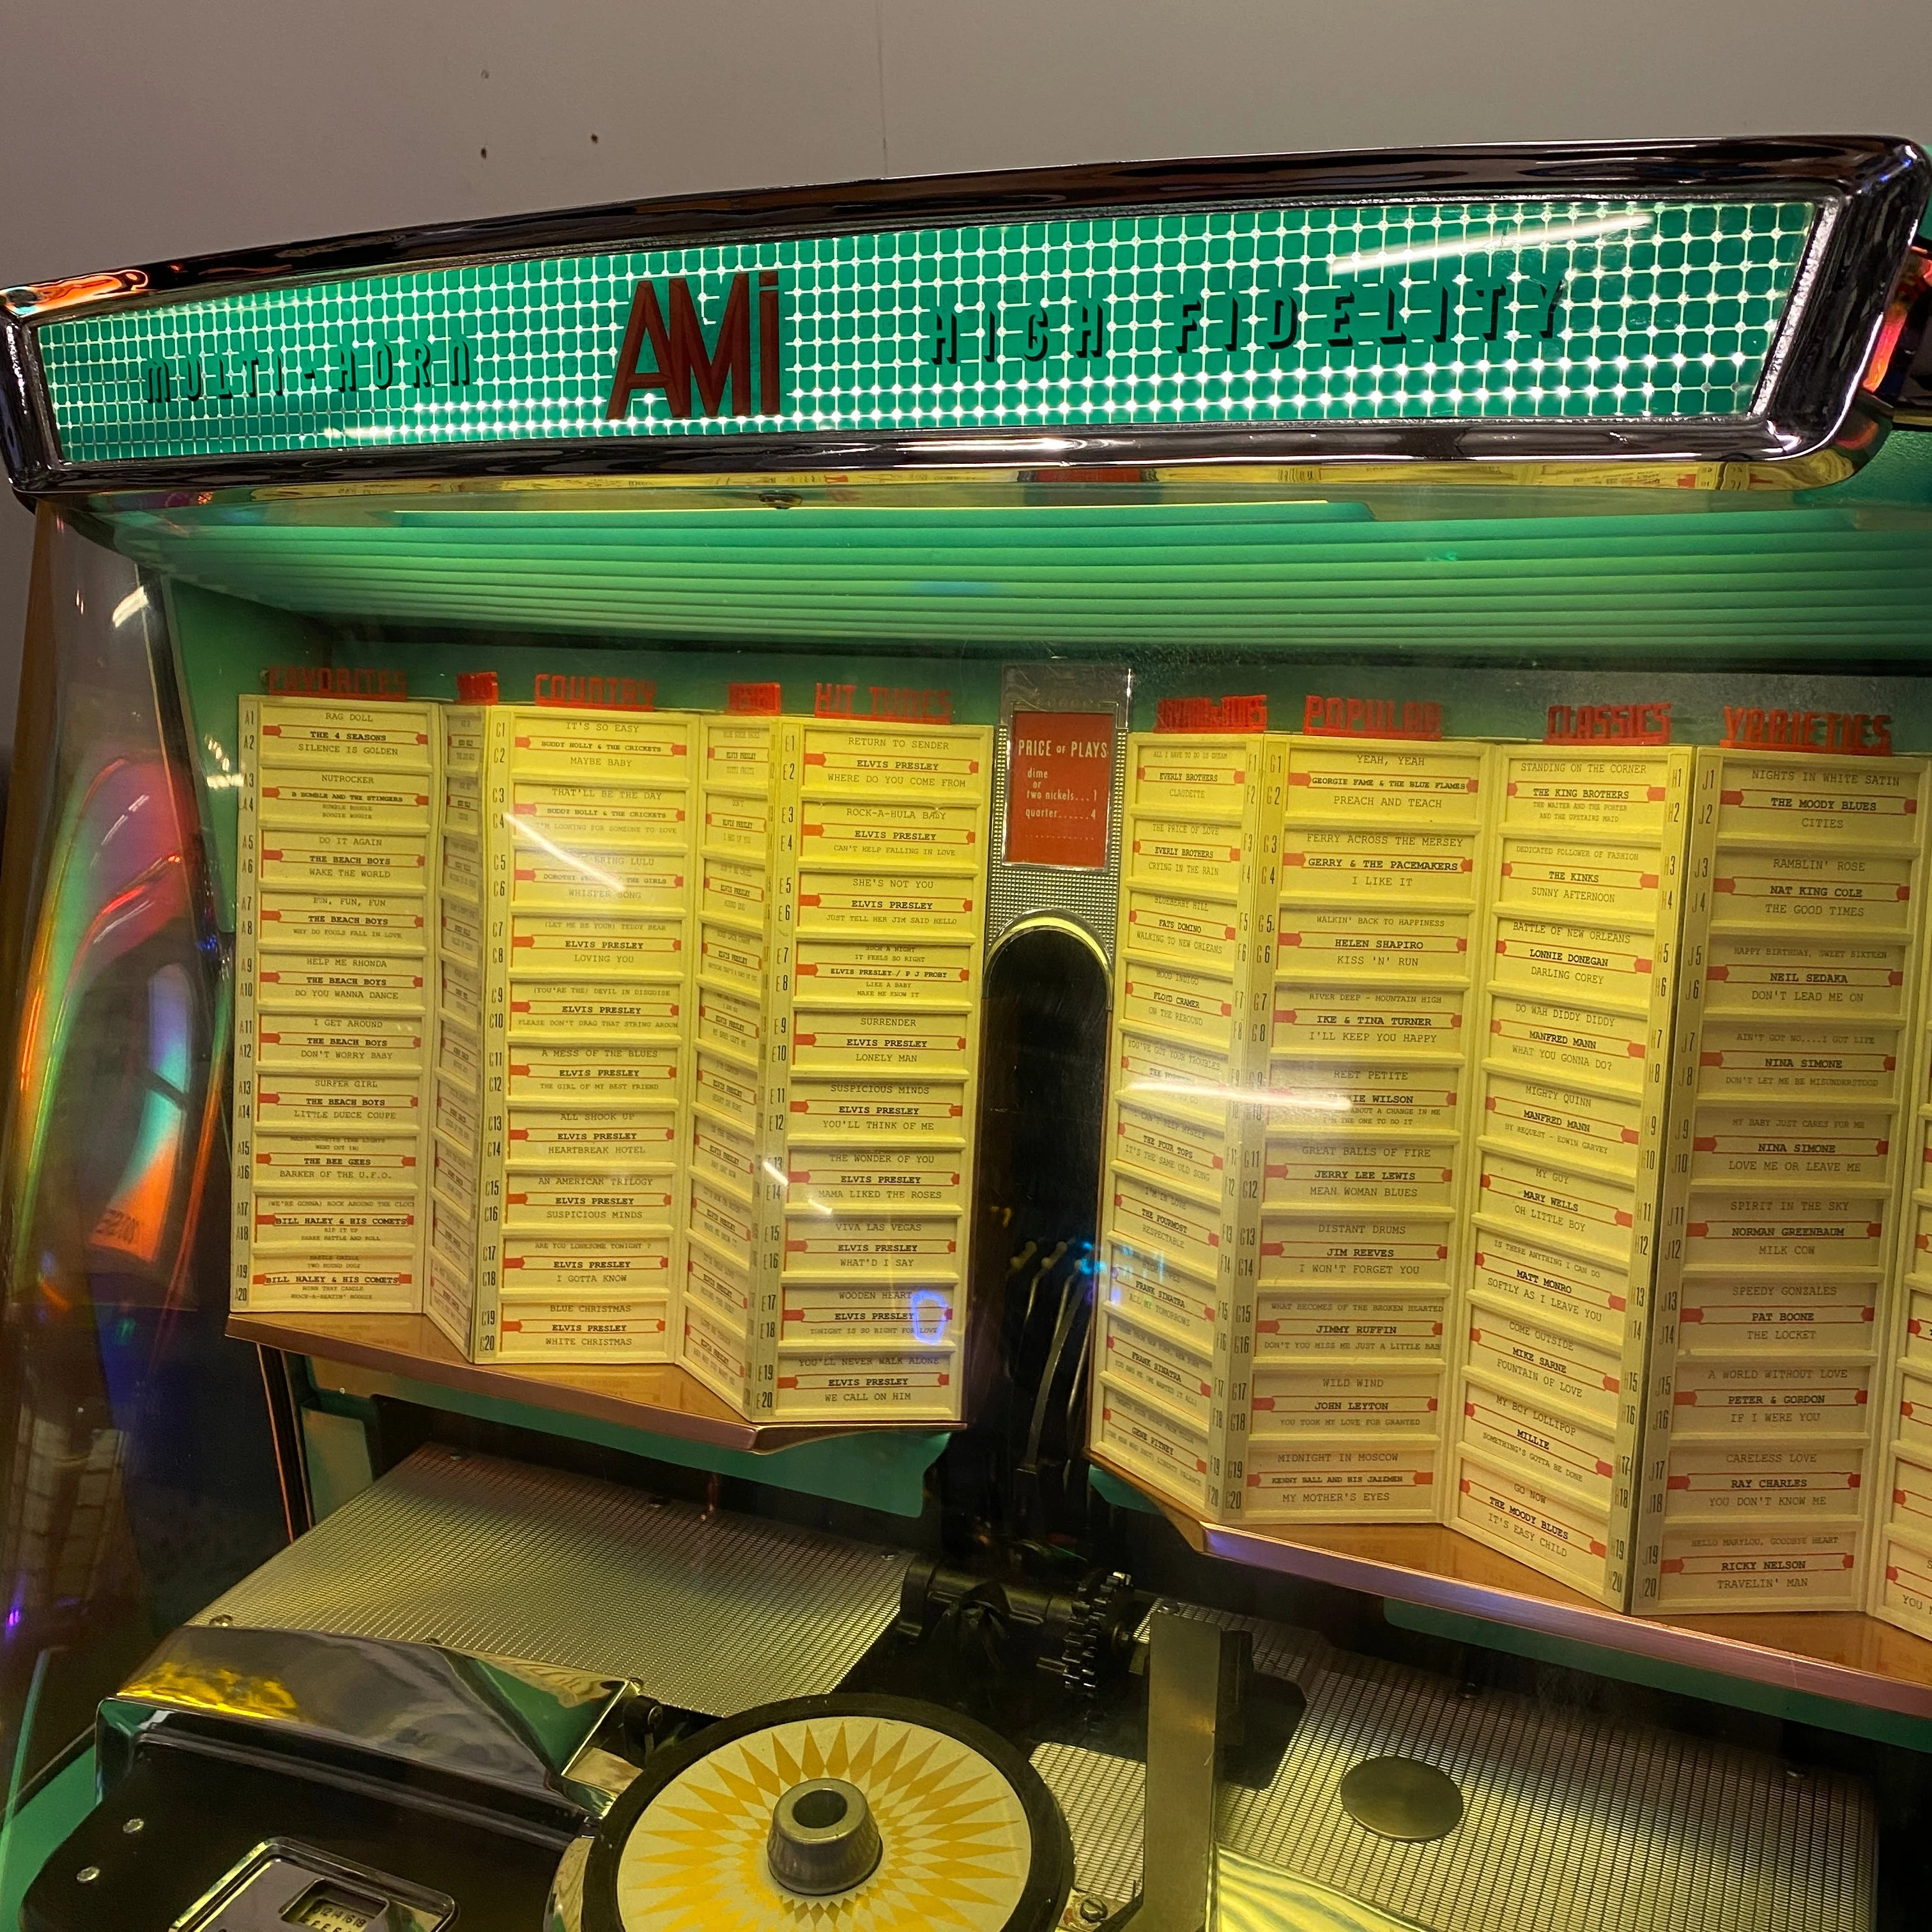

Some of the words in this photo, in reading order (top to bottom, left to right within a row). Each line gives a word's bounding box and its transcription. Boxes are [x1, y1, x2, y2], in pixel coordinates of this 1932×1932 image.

[930, 299, 1104, 365] HIGH
[1175, 280, 1563, 355] FIDELITY
[146, 331, 471, 404] MULTI-HORN
[325, 712, 344, 721] RAG
[349, 712, 374, 722] DOLL
[565, 720, 591, 731] IT'S
[596, 721, 610, 732] SO
[614, 722, 640, 733] EASY
[310, 731, 328, 740] THE
[334, 732, 341, 740] 4
[345, 732, 387, 742] SEASONS
[848, 735, 887, 747] RETURN
[892, 737, 906, 748] TO
[911, 740, 949, 750] SENDER
[298, 743, 341, 753] SILENCE
[346, 746, 358, 754] IS
[363, 747, 398, 756] GOLDEN
[1018, 739, 1052, 756] PRICE
[1071, 740, 1108, 758] PLAYS
[493, 747, 505, 763] C2
[1356, 754, 1392, 764] YEAH,
[1397, 755, 1425, 766] YEAH
[570, 756, 602, 766] MAYBE
[607, 758, 632, 767] BABY
[856, 760, 889, 769] ELVIS
[894, 761, 939, 770] PRESLEY
[1270, 755, 1282, 774] G1
[783, 763, 795, 780] E2
[1027, 767, 1048, 778] dime
[1521, 762, 1566, 772] STANDING
[1570, 762, 1582, 772] ON
[1587, 764, 1605, 773] THE
[1609, 763, 1646, 774] CORNER
[321, 772, 374, 784] NUTROCKER
[827, 773, 860, 783] WHERE
[866, 775, 879, 784] DO
[884, 776, 904, 785] YOU
[909, 777, 935, 786] COME
[941, 779, 966, 788] FROM
[1159, 772, 1183, 781] EVERLY
[1185, 774, 1218, 783] BROTHERS
[1703, 769, 1715, 790] J1
[1751, 769, 1795, 781] NIGHTS
[1802, 770, 1816, 782] IN
[1822, 771, 1859, 784] WHITE
[1864, 773, 1900, 786] SATIN
[493, 788, 504, 803] C3
[1027, 790, 1042, 799] two
[1266, 786, 1280, 805] G2
[1533, 788, 1550, 797] THE
[1554, 789, 1578, 798] KING
[1582, 790, 1629, 799] BROTHERS
[1333, 795, 1374, 806] PREACH
[1380, 797, 1402, 807] AND
[1407, 798, 1443, 808] TEACH
[1770, 799, 1793, 808] THE
[1798, 799, 1836, 810] MOODY
[1841, 801, 1876, 811] BLUES
[781, 806, 793, 823] E3
[1091, 809, 1096, 820] 4
[1698, 804, 1713, 824] J2
[1801, 818, 1844, 829] CITIES
[319, 836, 331, 845] DO
[337, 837, 348, 845] IT
[353, 836, 383, 846] AGAIN
[780, 834, 793, 851] E4
[1264, 834, 1277, 854] G3
[309, 855, 328, 864] THE
[332, 855, 362, 865] BEACH
[367, 857, 391, 866] BOYS
[1308, 859, 1343, 868] GERRY
[1349, 859, 1356, 868] &
[1362, 860, 1383, 869] THE
[1390, 861, 1458, 871] PACEMAKERS
[1773, 858, 1828, 870] RAMBLIN'
[1837, 861, 1866, 872] ROSE
[309, 868, 334, 877] WAKE
[337, 869, 356, 877] THE
[360, 870, 391, 878] WORLD
[1694, 857, 1708, 877] J3
[1261, 866, 1275, 884] G4
[1548, 872, 1566, 882] THE
[1570, 873, 1599, 883] KINKS
[852, 877, 884, 887] SHE'S
[889, 877, 910, 888] NOT
[915, 878, 934, 889] YOU
[1531, 886, 1560, 898] SUNNY
[1563, 889, 1616, 903] AFTERNOON
[1769, 886, 1793, 896] NAT
[1798, 887, 1828, 897] KING
[1834, 888, 1863, 898] COLE
[565, 940, 596, 949] ELVIS
[601, 941, 644, 950] PRESLEY
[1335, 939, 1370, 949] HELEN
[1376, 940, 1424, 949] SHAPIRO
[574, 954, 611, 963] LOVING
[1531, 966, 1570, 980] DARLING
[1574, 972, 1604, 985] COREY
[860, 1015, 917, 1027] SURRENDER
[855, 1053, 893, 1062] LONELY
[822, 1120, 860, 1129] YOU'LL
[866, 1121, 898, 1130] THINK
[902, 1122, 917, 1130] OF
[921, 1122, 934, 1130] ME
[548, 1146, 609, 1154] HEARTBREAK
[615, 1146, 646, 1154] HOTEL
[303, 1157, 321, 1165] THE
[326, 1157, 344, 1166] BEE
[348, 1158, 372, 1167] GEES
[279, 1170, 315, 1178] BARKER
[336, 1170, 355, 1179] THE
[358, 1171, 392, 1179] U.F.O.
[1314, 1171, 1349, 1180] JERRY
[1354, 1172, 1376, 1181] LEE
[1381, 1172, 1416, 1181] LEWIS
[1523, 1190, 1546, 1204] MARY
[1550, 1197, 1579, 1212] WELLS
[546, 1210, 607, 1219] SUSPICIOUS
[611, 1211, 643, 1219] MINDS
[275, 1217, 299, 1225] BILL
[303, 1217, 334, 1225] HALEY
[338, 1217, 345, 1225] &
[349, 1217, 368, 1226] HIS
[372, 1218, 408, 1226] COMETS
[1326, 1249, 1348, 1257] JIM
[1353, 1249, 1394, 1257] REEVES
[1751, 1313, 1774, 1321] PAT
[1779, 1313, 1814, 1321] BOONE
[545, 1337, 576, 1346] WHITE
[1731, 1479, 1753, 1488] RAY
[1758, 1479, 1807, 1488] CHARLES
